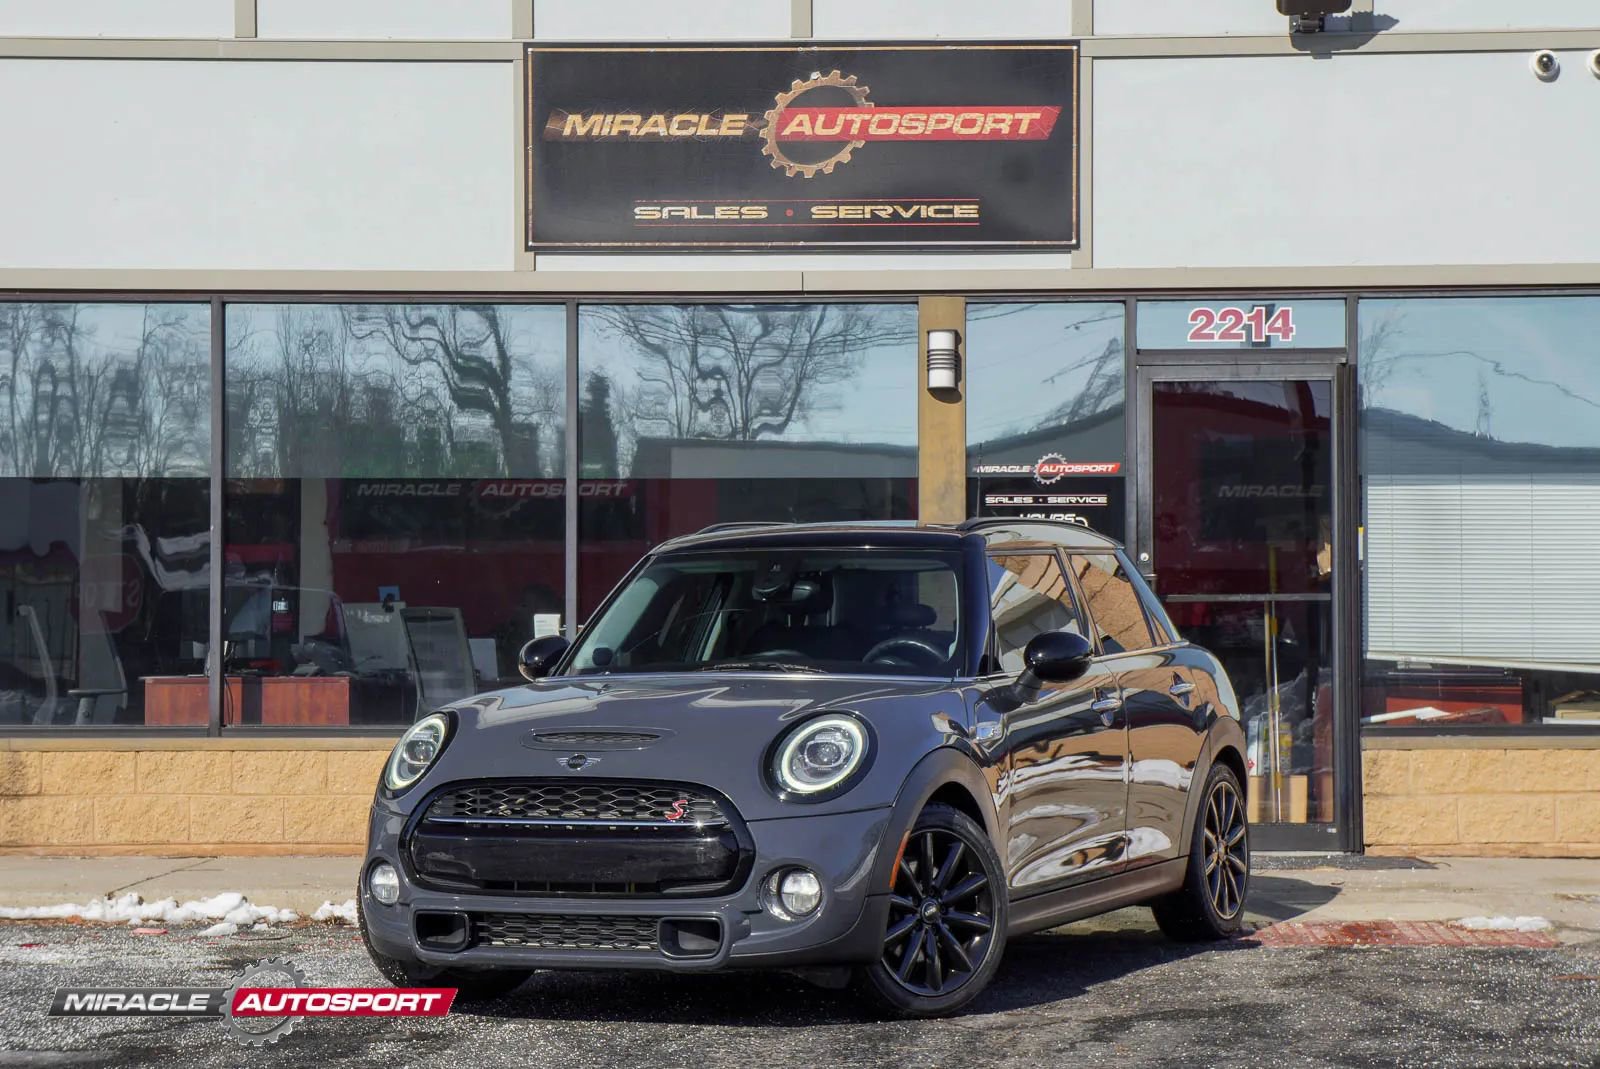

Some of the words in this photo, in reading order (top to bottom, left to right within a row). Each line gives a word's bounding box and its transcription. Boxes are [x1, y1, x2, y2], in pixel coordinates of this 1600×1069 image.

[563, 113, 748, 136] MIRACLE
[781, 112, 1042, 135] AUTOSPORT
[633, 205, 768, 220] SALES
[811, 204, 980, 219] SERVICE
[1187, 307, 1296, 343] 2214
[977, 465, 1031, 473] MIRACLE
[1039, 464, 1115, 472] AUTOSPORT
[356, 483, 461, 496] MIRACLE
[481, 483, 628, 497] AUTOSORT
[1218, 484, 1324, 498] MIRACLE
[985, 496, 1033, 504] SALES
[1047, 496, 1108, 504] SERVICE
